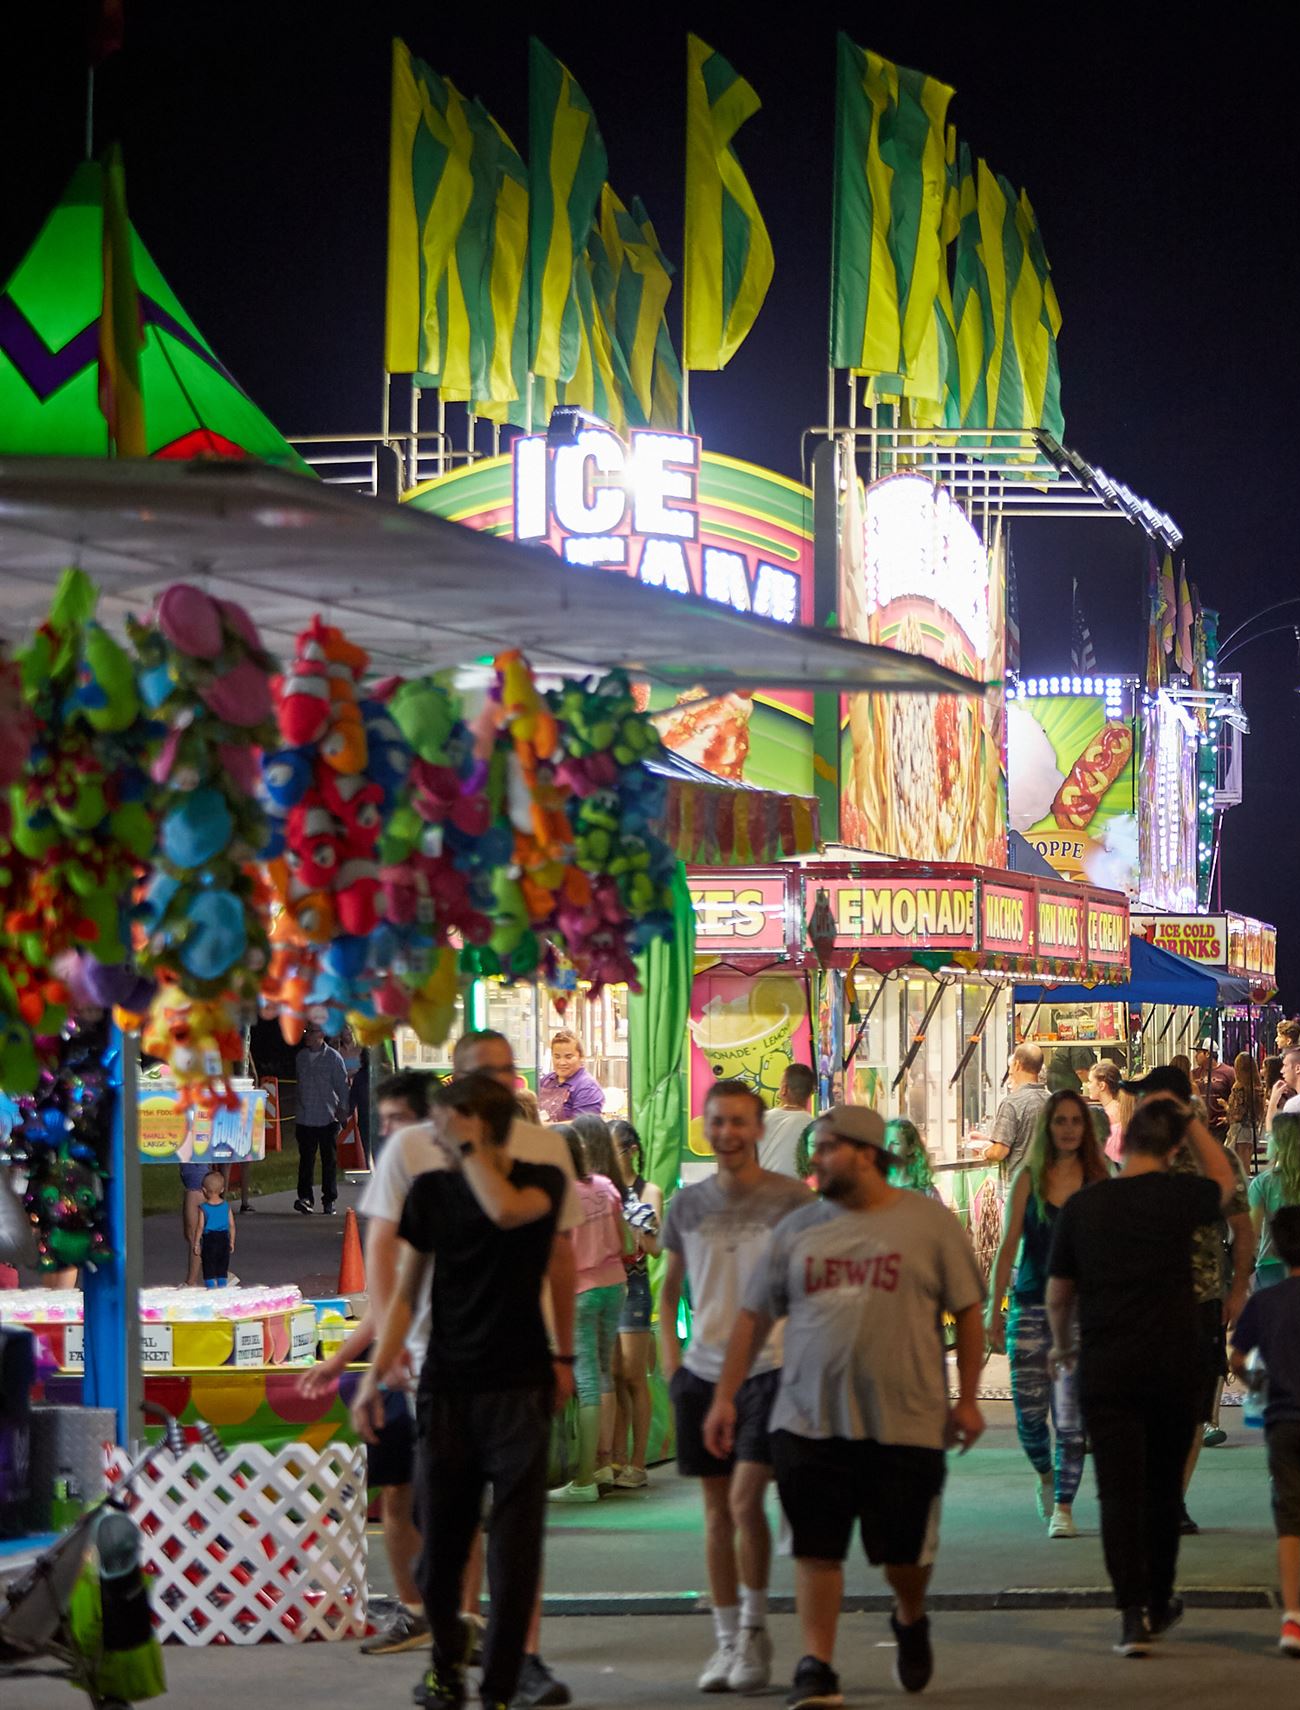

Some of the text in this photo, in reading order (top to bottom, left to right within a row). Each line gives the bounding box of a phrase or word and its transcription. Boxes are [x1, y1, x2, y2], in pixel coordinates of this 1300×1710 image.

[515, 429, 698, 540] ICE
[1031, 840, 1084, 859] OPPE
[986, 893, 1024, 942] NACHOS
[1039, 902, 1078, 947] ORN DOGS
[1088, 910, 1123, 953] CE CREAM
[1160, 924, 1215, 937] ICE COLD
[708, 1046, 751, 1060] ONADE
[805, 1253, 902, 1297] LEWIS
